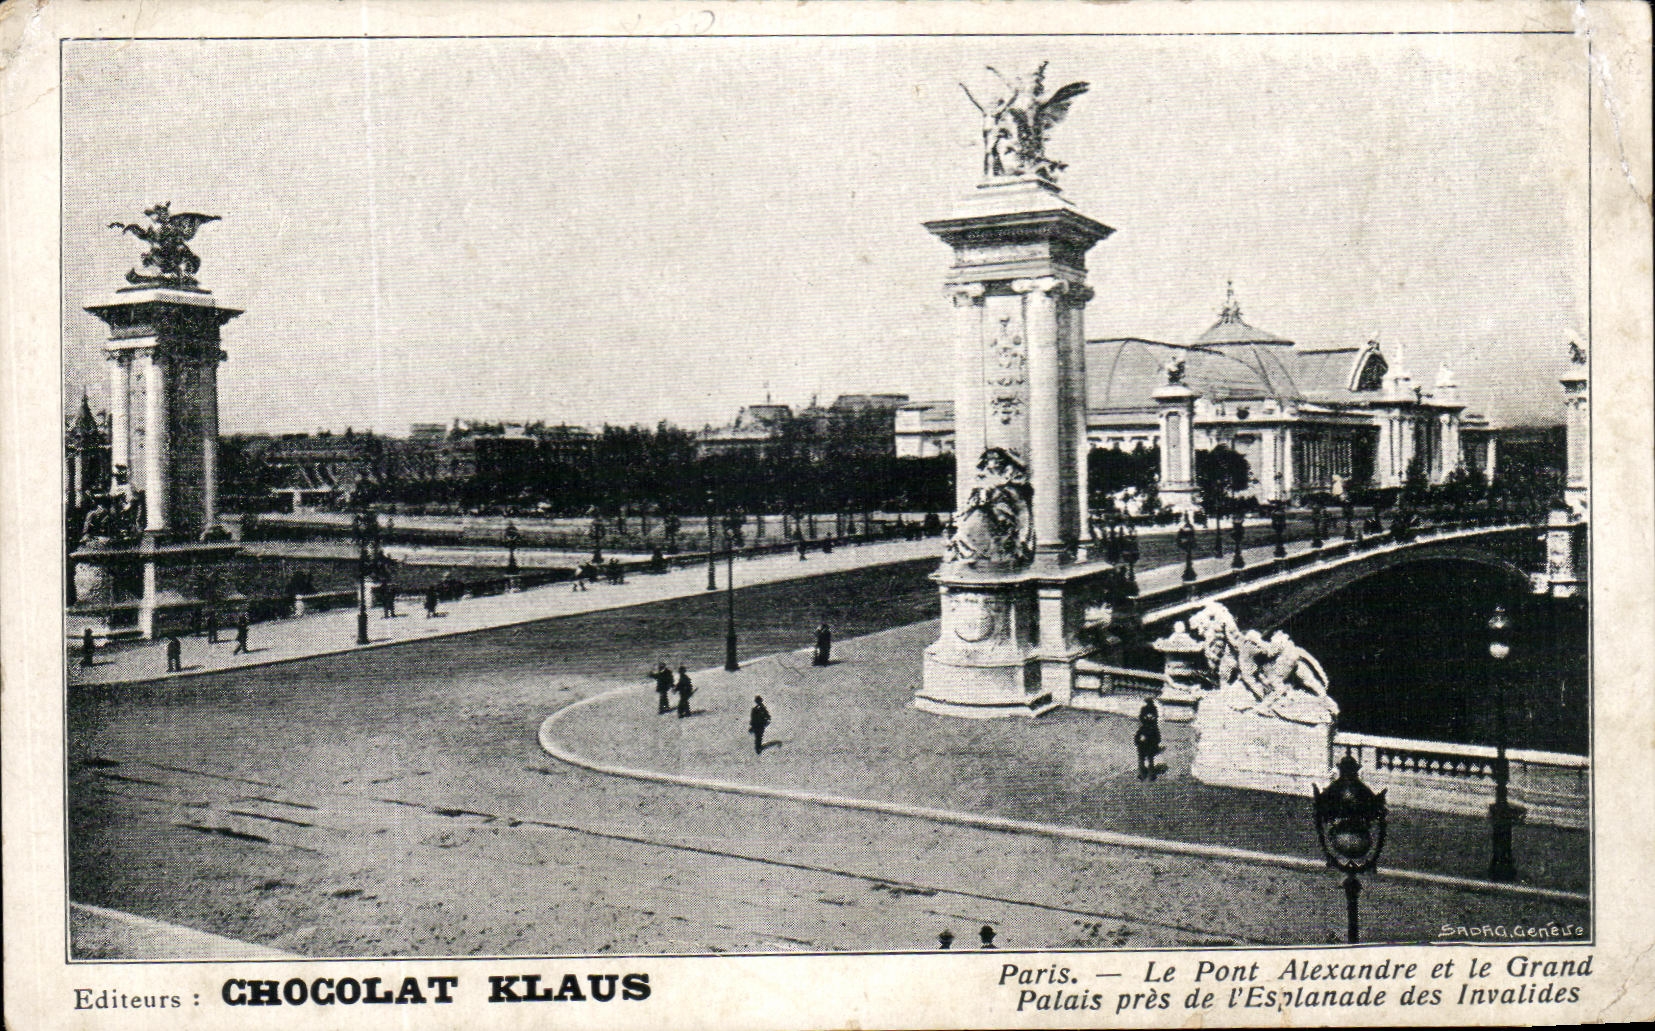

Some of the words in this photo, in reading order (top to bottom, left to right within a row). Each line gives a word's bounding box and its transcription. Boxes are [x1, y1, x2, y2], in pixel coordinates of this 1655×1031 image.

[999, 965, 1078, 985] Paris.
[1145, 961, 1176, 983] Le
[1196, 961, 1259, 982] Pont
[1278, 959, 1417, 981] Alexandre
[1431, 959, 1454, 979] et
[1469, 958, 1492, 979] le
[1507, 955, 1594, 977] Grand
[74, 989, 182, 1010] Editeurs
[221, 976, 459, 1006] CHOCOLAT
[488, 973, 652, 1003] KLAUS
[1017, 989, 1103, 1012] Palais
[1116, 988, 1171, 1015] près
[1184, 988, 1215, 1009] de
[1400, 985, 1443, 1006] des
[1457, 983, 1581, 1005] Invalides
